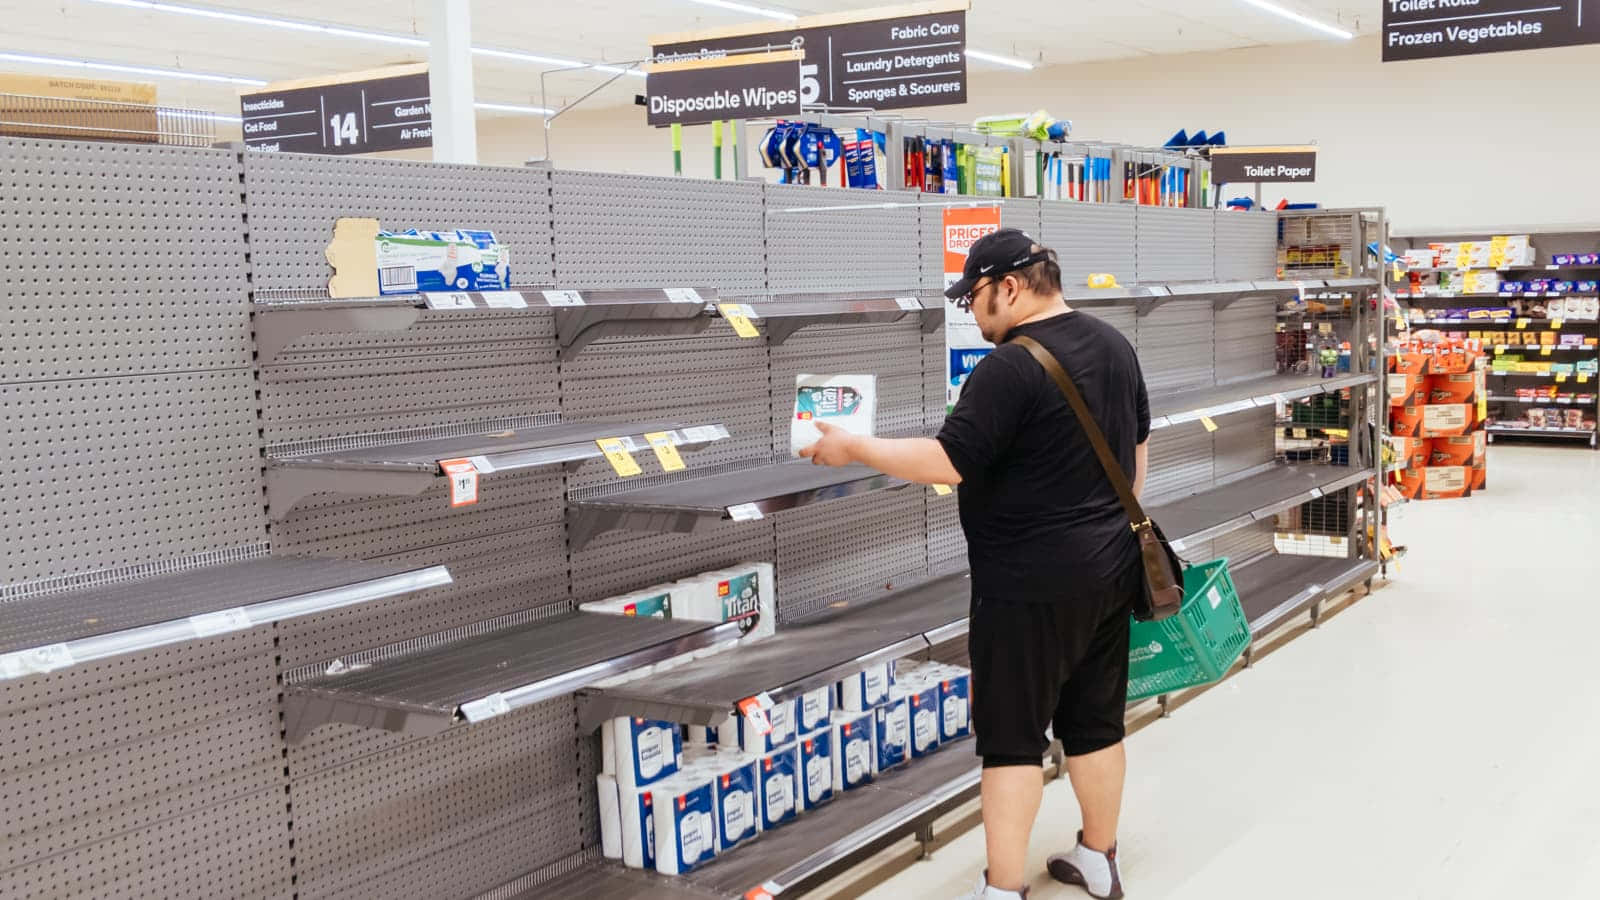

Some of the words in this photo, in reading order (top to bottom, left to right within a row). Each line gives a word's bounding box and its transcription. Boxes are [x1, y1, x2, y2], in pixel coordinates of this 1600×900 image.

[1388, 0, 1435, 13] Toilet
[891, 24, 927, 40] Fabric
[930, 21, 960, 37] Care
[1388, 29, 1443, 47] Frozen
[1446, 20, 1542, 44] Vegetables
[846, 54, 893, 74] Laundry
[894, 50, 960, 70] Detergents
[848, 84, 896, 103] Sponges
[898, 84, 908, 97] &
[909, 79, 961, 96] Scourers
[242, 99, 285, 112] Insecticides
[650, 91, 740, 117] Disposable
[742, 86, 797, 111] Wipes
[394, 105, 424, 117] Garden
[244, 123, 259, 133] Cat
[259, 121, 278, 132] Food
[330, 112, 359, 147] 14
[400, 128, 411, 140] Air
[1243, 165, 1275, 177] Toilet
[1277, 165, 1312, 179] Paper
[961, 354, 986, 369] VIV
[724, 593, 759, 618] Titan
